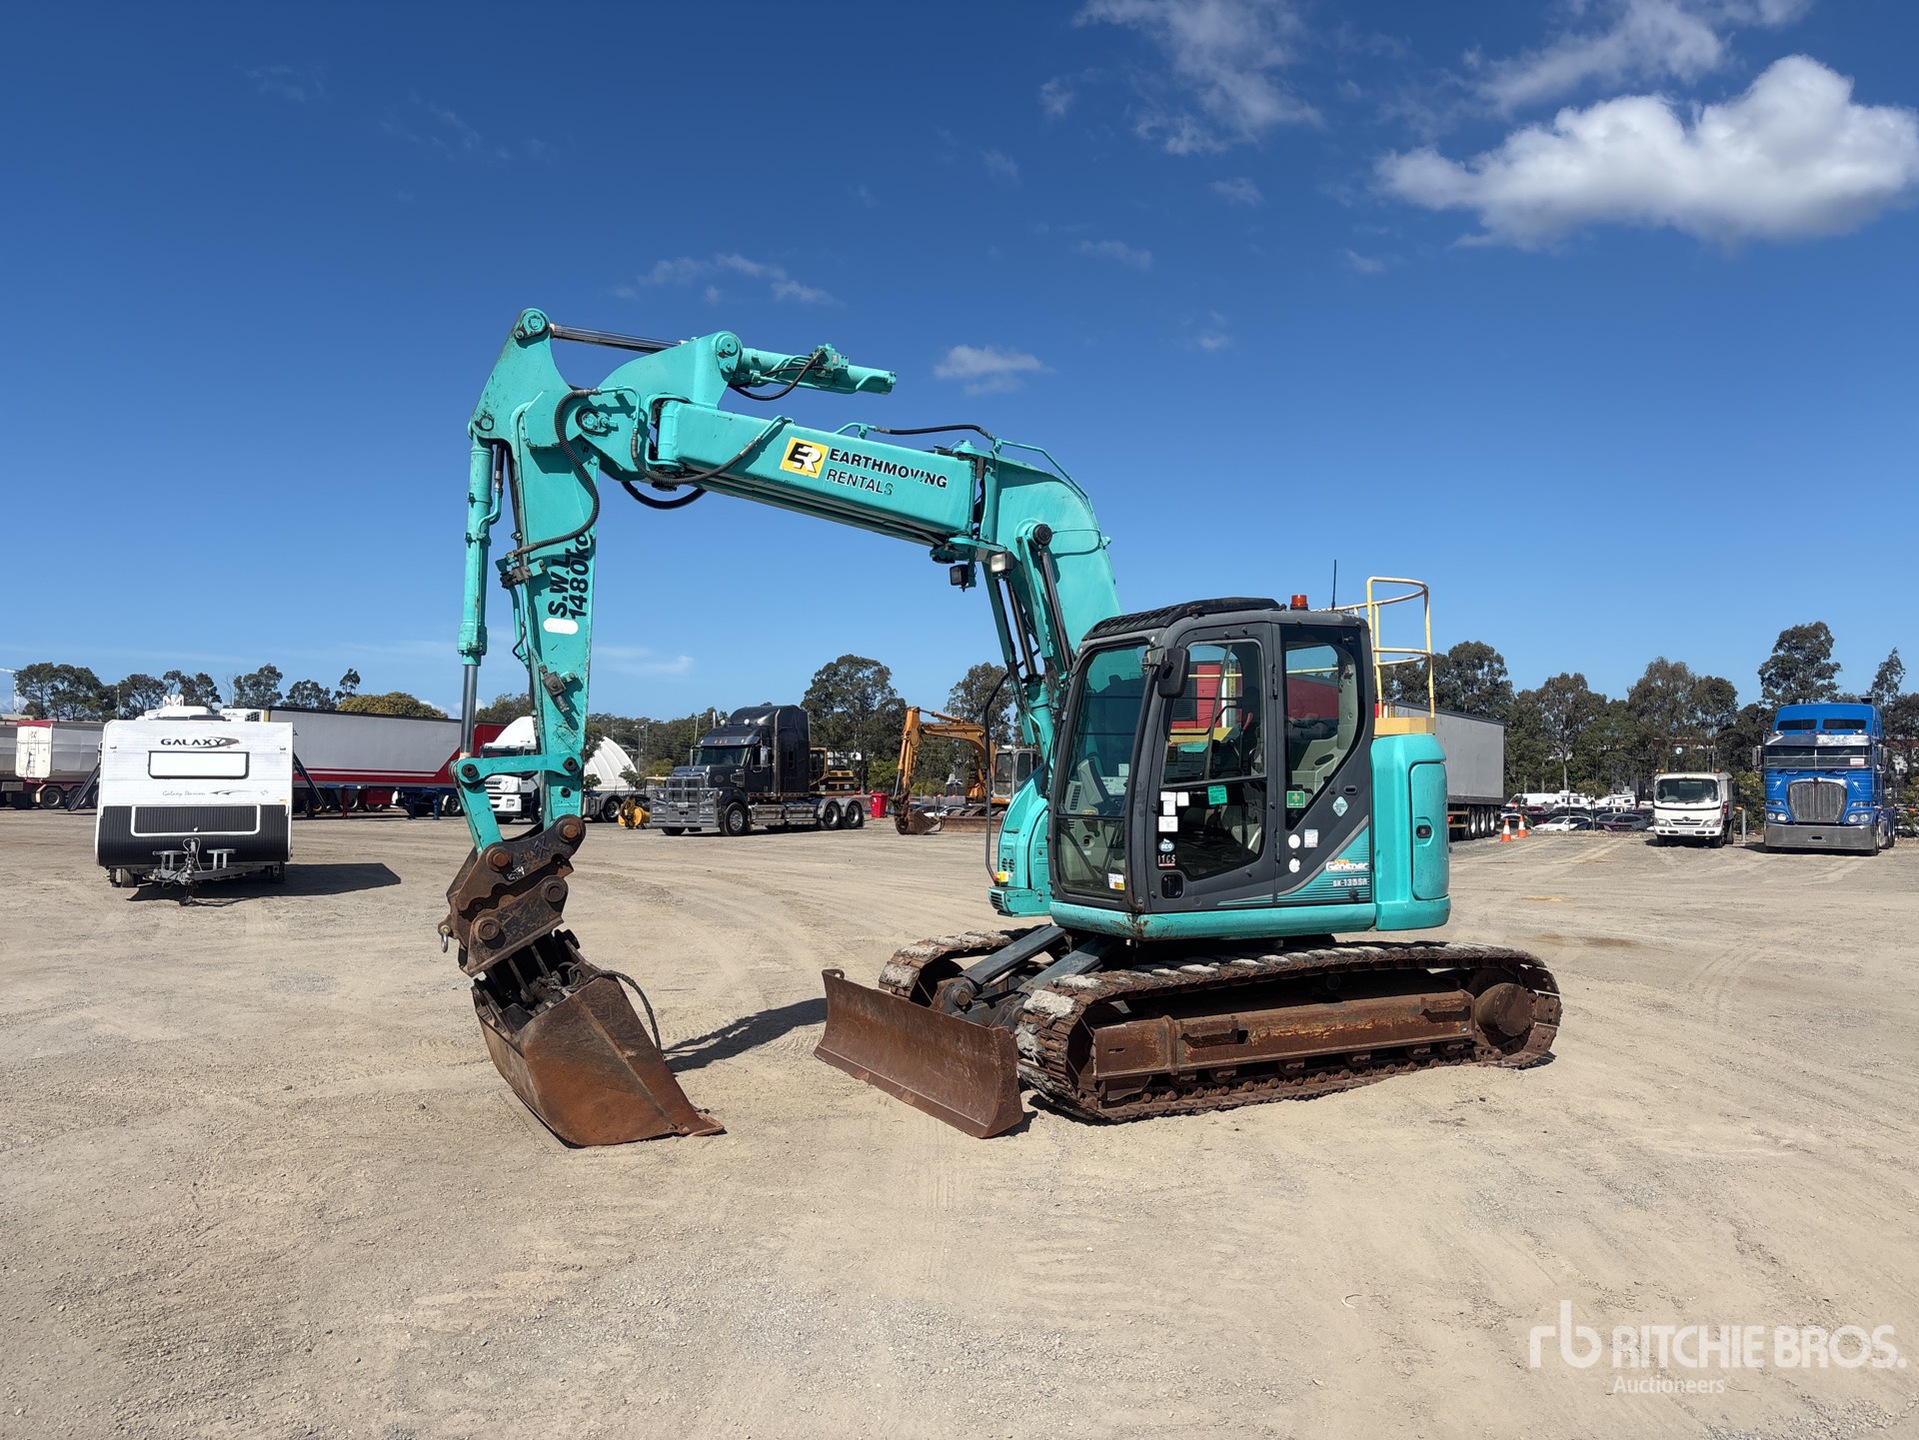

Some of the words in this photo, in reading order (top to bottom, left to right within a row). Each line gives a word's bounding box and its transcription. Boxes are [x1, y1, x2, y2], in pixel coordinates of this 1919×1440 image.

[826, 469, 895, 496] RENTALS
[829, 449, 948, 489] EARTHMOVING
[160, 738, 225, 746] GALAXY
